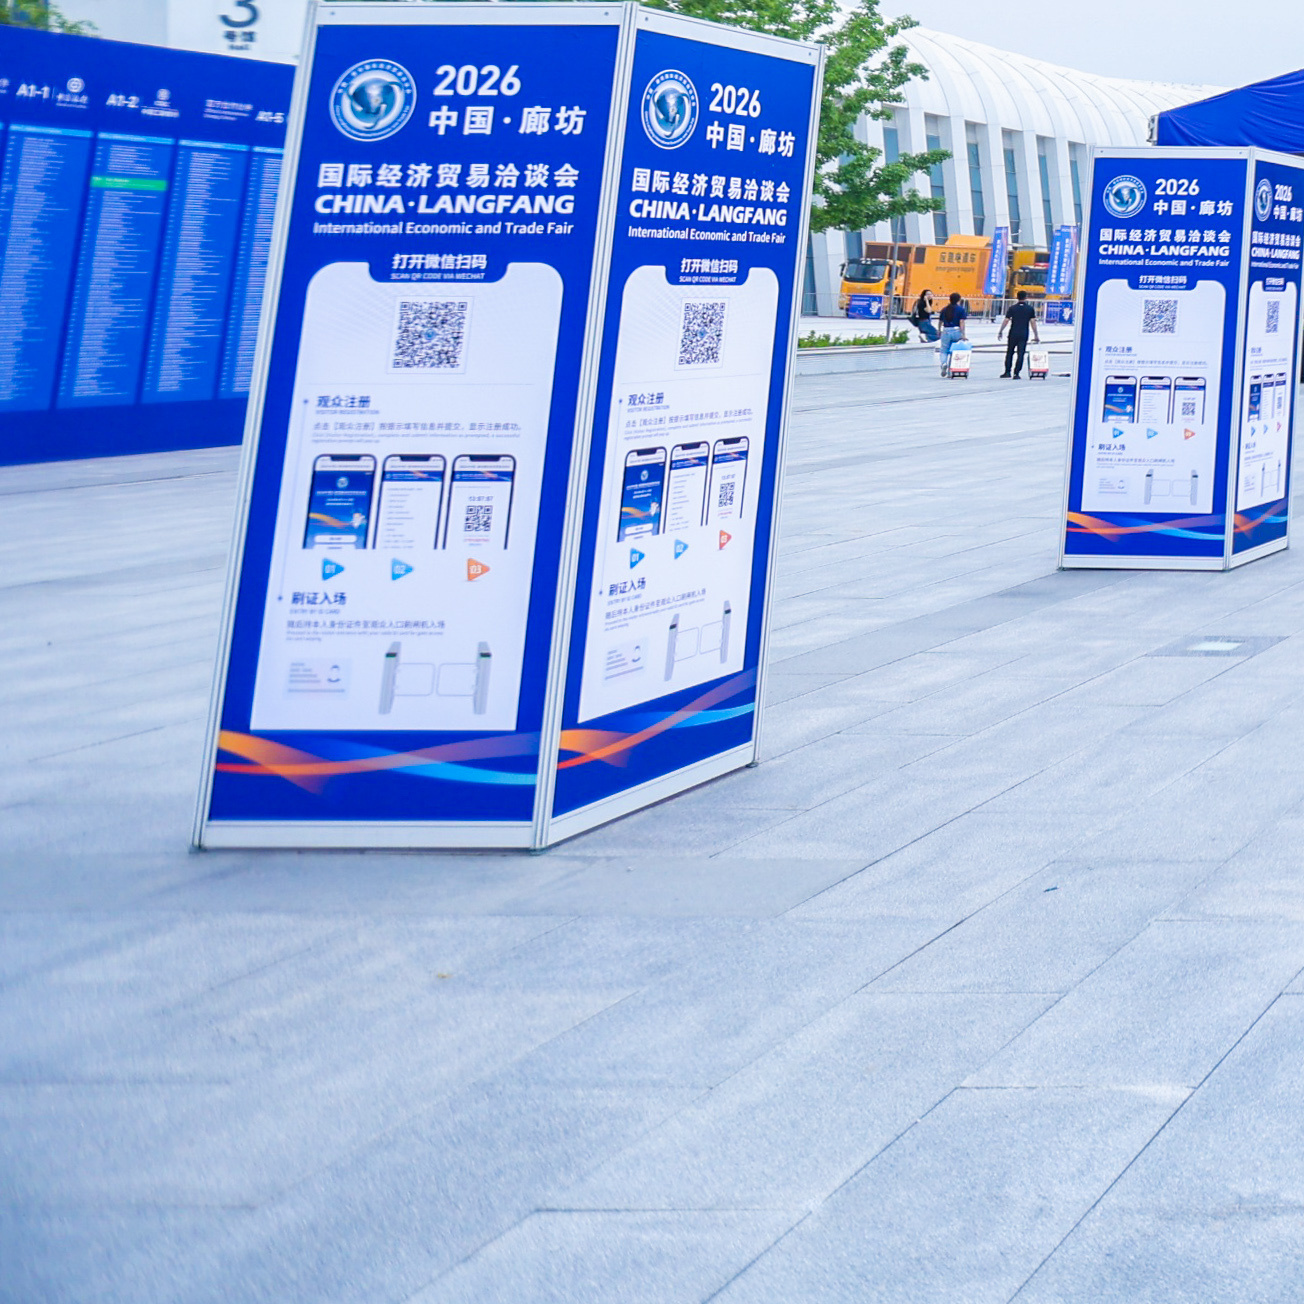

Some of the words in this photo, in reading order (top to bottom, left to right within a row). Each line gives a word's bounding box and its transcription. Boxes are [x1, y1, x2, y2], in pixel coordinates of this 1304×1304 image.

[432, 65, 523, 95] 2026
[16, 83, 50, 99] A1-1
[708, 81, 762, 118] 2026
[427, 105, 587, 135] 中国·廊坊
[704, 119, 796, 158] 中国·廊坊
[315, 163, 580, 188] 国际经济贸易洽谈会
[631, 167, 791, 203] 国际经济贸易洽谈会
[1154, 178, 1200, 195] 2026
[1274, 184, 1291, 201] 2026
[312, 195, 575, 213] CHINA·LANGFANG
[628, 198, 787, 226] CHINA·LANGFANG
[1153, 199, 1233, 215] 中国·廊坊
[312, 221, 405, 234] International
[405, 221, 473, 234] Economic
[474, 221, 502, 234] and
[503, 221, 545, 234] Trade
[546, 221, 574, 234] Fair
[627, 224, 689, 239] International
[689, 227, 730, 241] Economic
[730, 230, 746, 242] and
[747, 230, 770, 243] Trade
[771, 232, 786, 243] Fair
[1098, 228, 1231, 242] 国际经济贸易洽谈会
[1097, 244, 1229, 256] CHINA·LANGFANG
[391, 253, 488, 269] 打开微信扫码
[679, 258, 738, 273] 打开微信扫码
[316, 396, 371, 407] 观众注册
[627, 392, 664, 406] 观众注册
[607, 576, 646, 597] 刷证入场
[291, 591, 347, 605] 刷证入场
